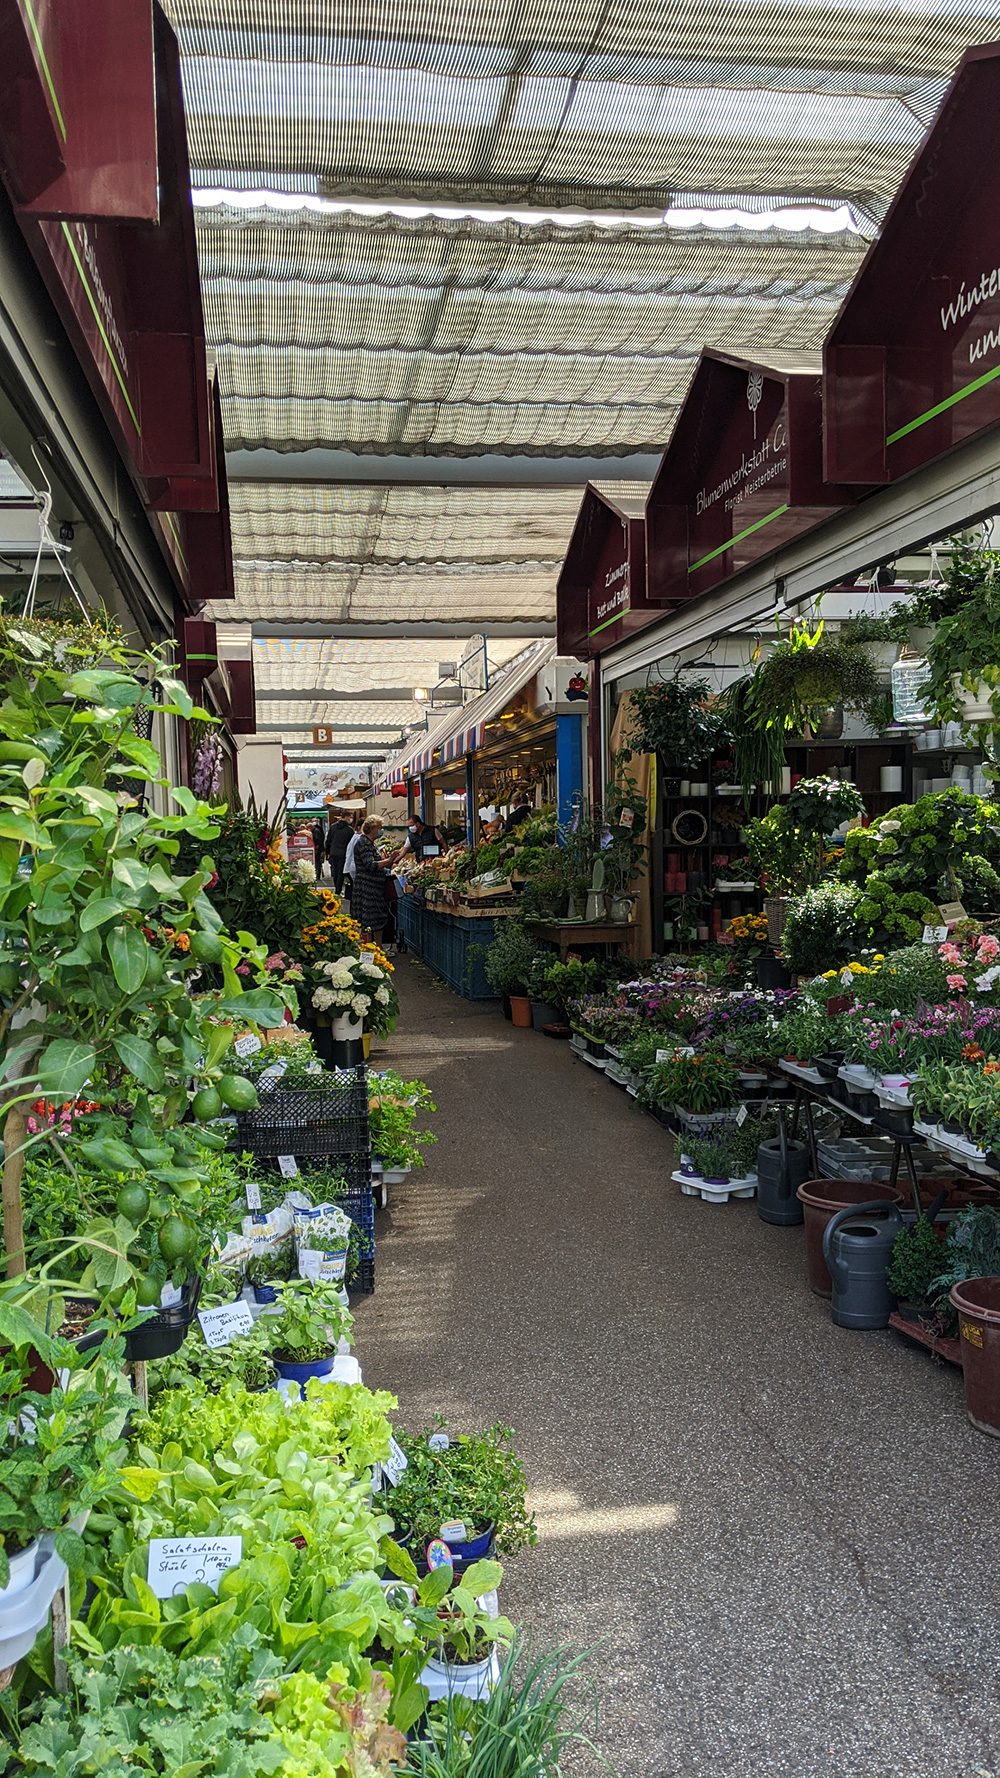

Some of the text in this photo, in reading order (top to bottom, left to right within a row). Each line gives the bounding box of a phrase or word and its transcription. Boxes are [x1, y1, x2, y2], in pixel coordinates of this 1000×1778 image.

[696, 438, 771, 516] Blumenwerkstatt
[724, 490, 743, 513] Florist
[317, 728, 328, 742] B
[203, 1312, 230, 1324] Zitronen
[219, 1313, 250, 1326] Basilikum
[158, 1559, 188, 1573] Stück
